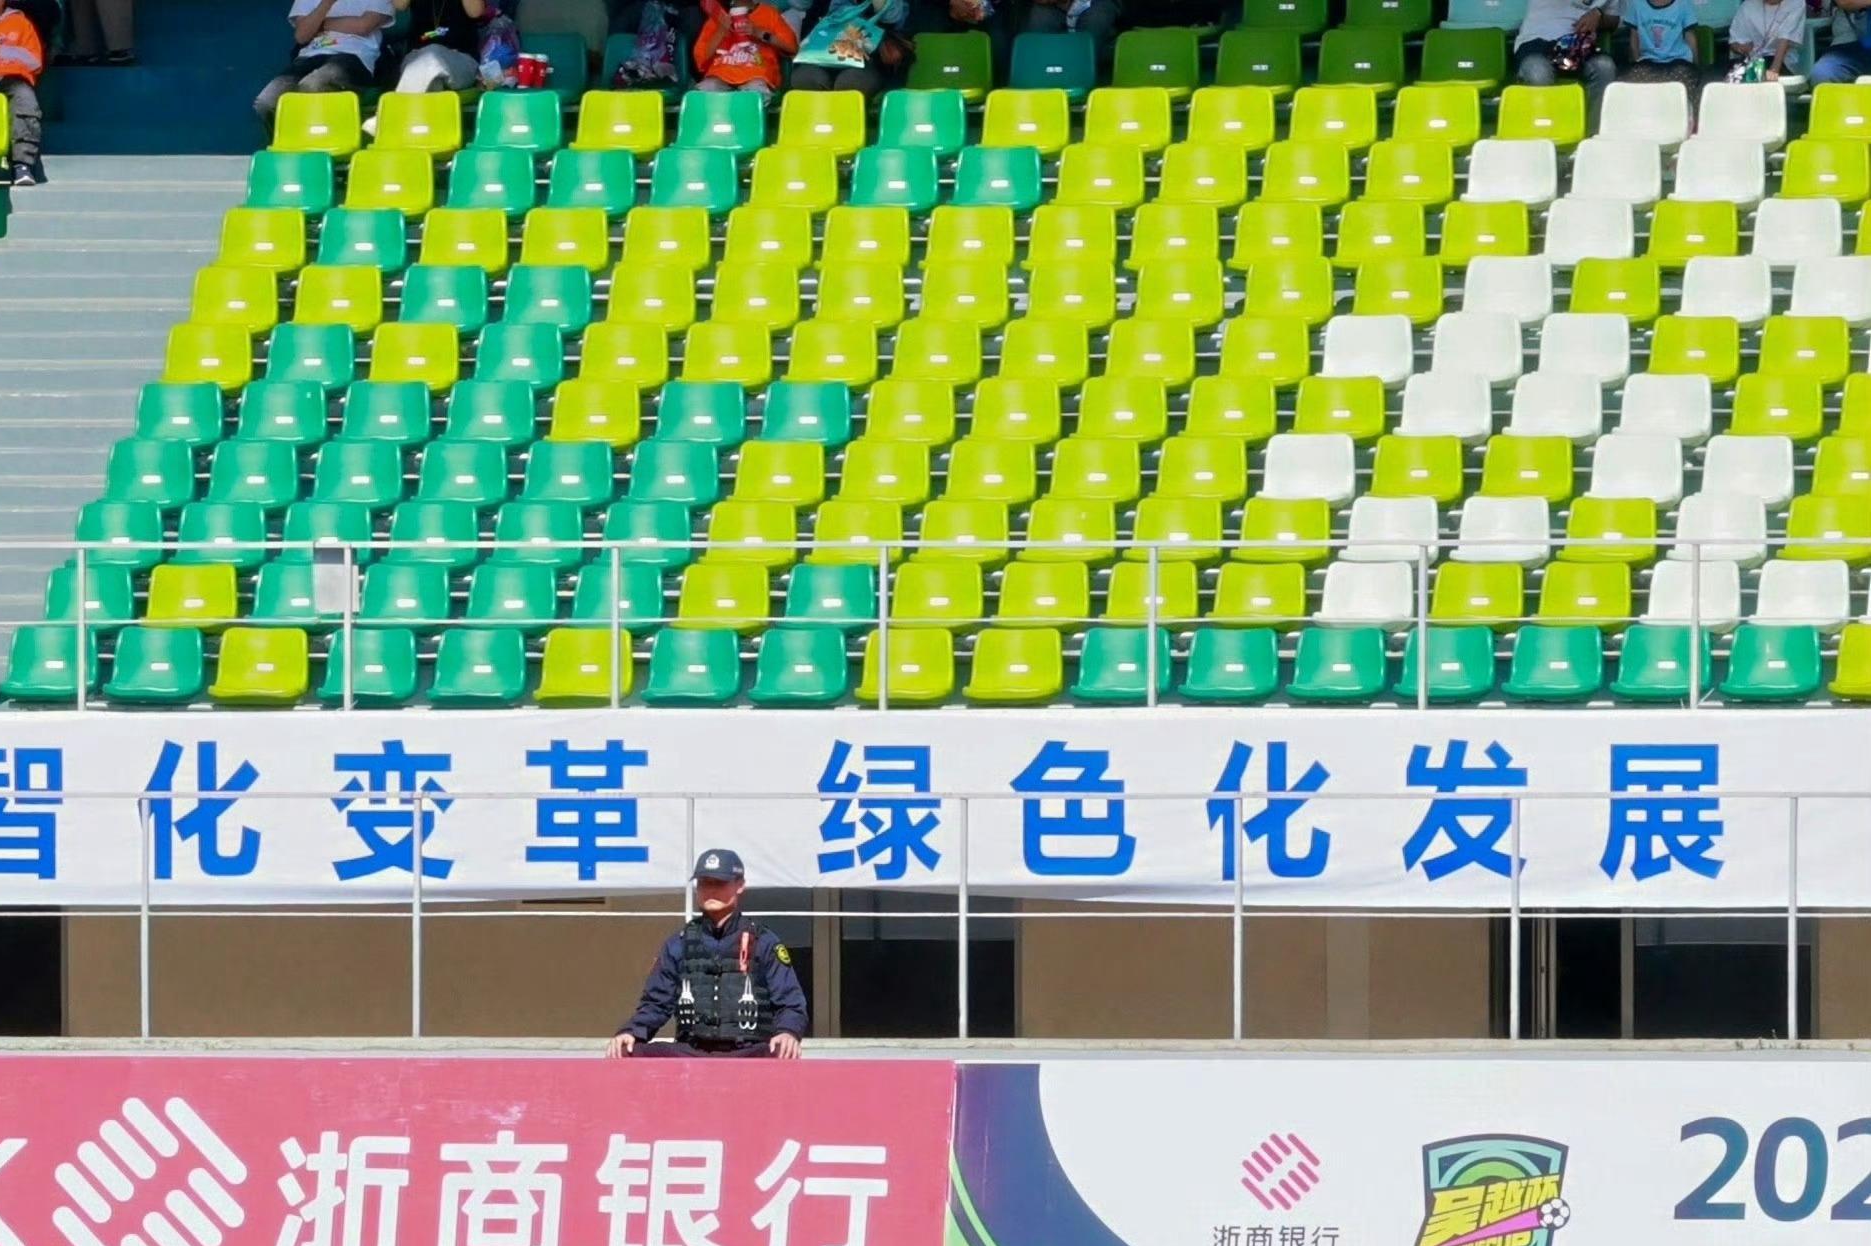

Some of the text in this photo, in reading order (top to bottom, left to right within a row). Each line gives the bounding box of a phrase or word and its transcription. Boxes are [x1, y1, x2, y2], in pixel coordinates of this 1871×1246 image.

[817, 738, 1725, 882] 绿色化发展
